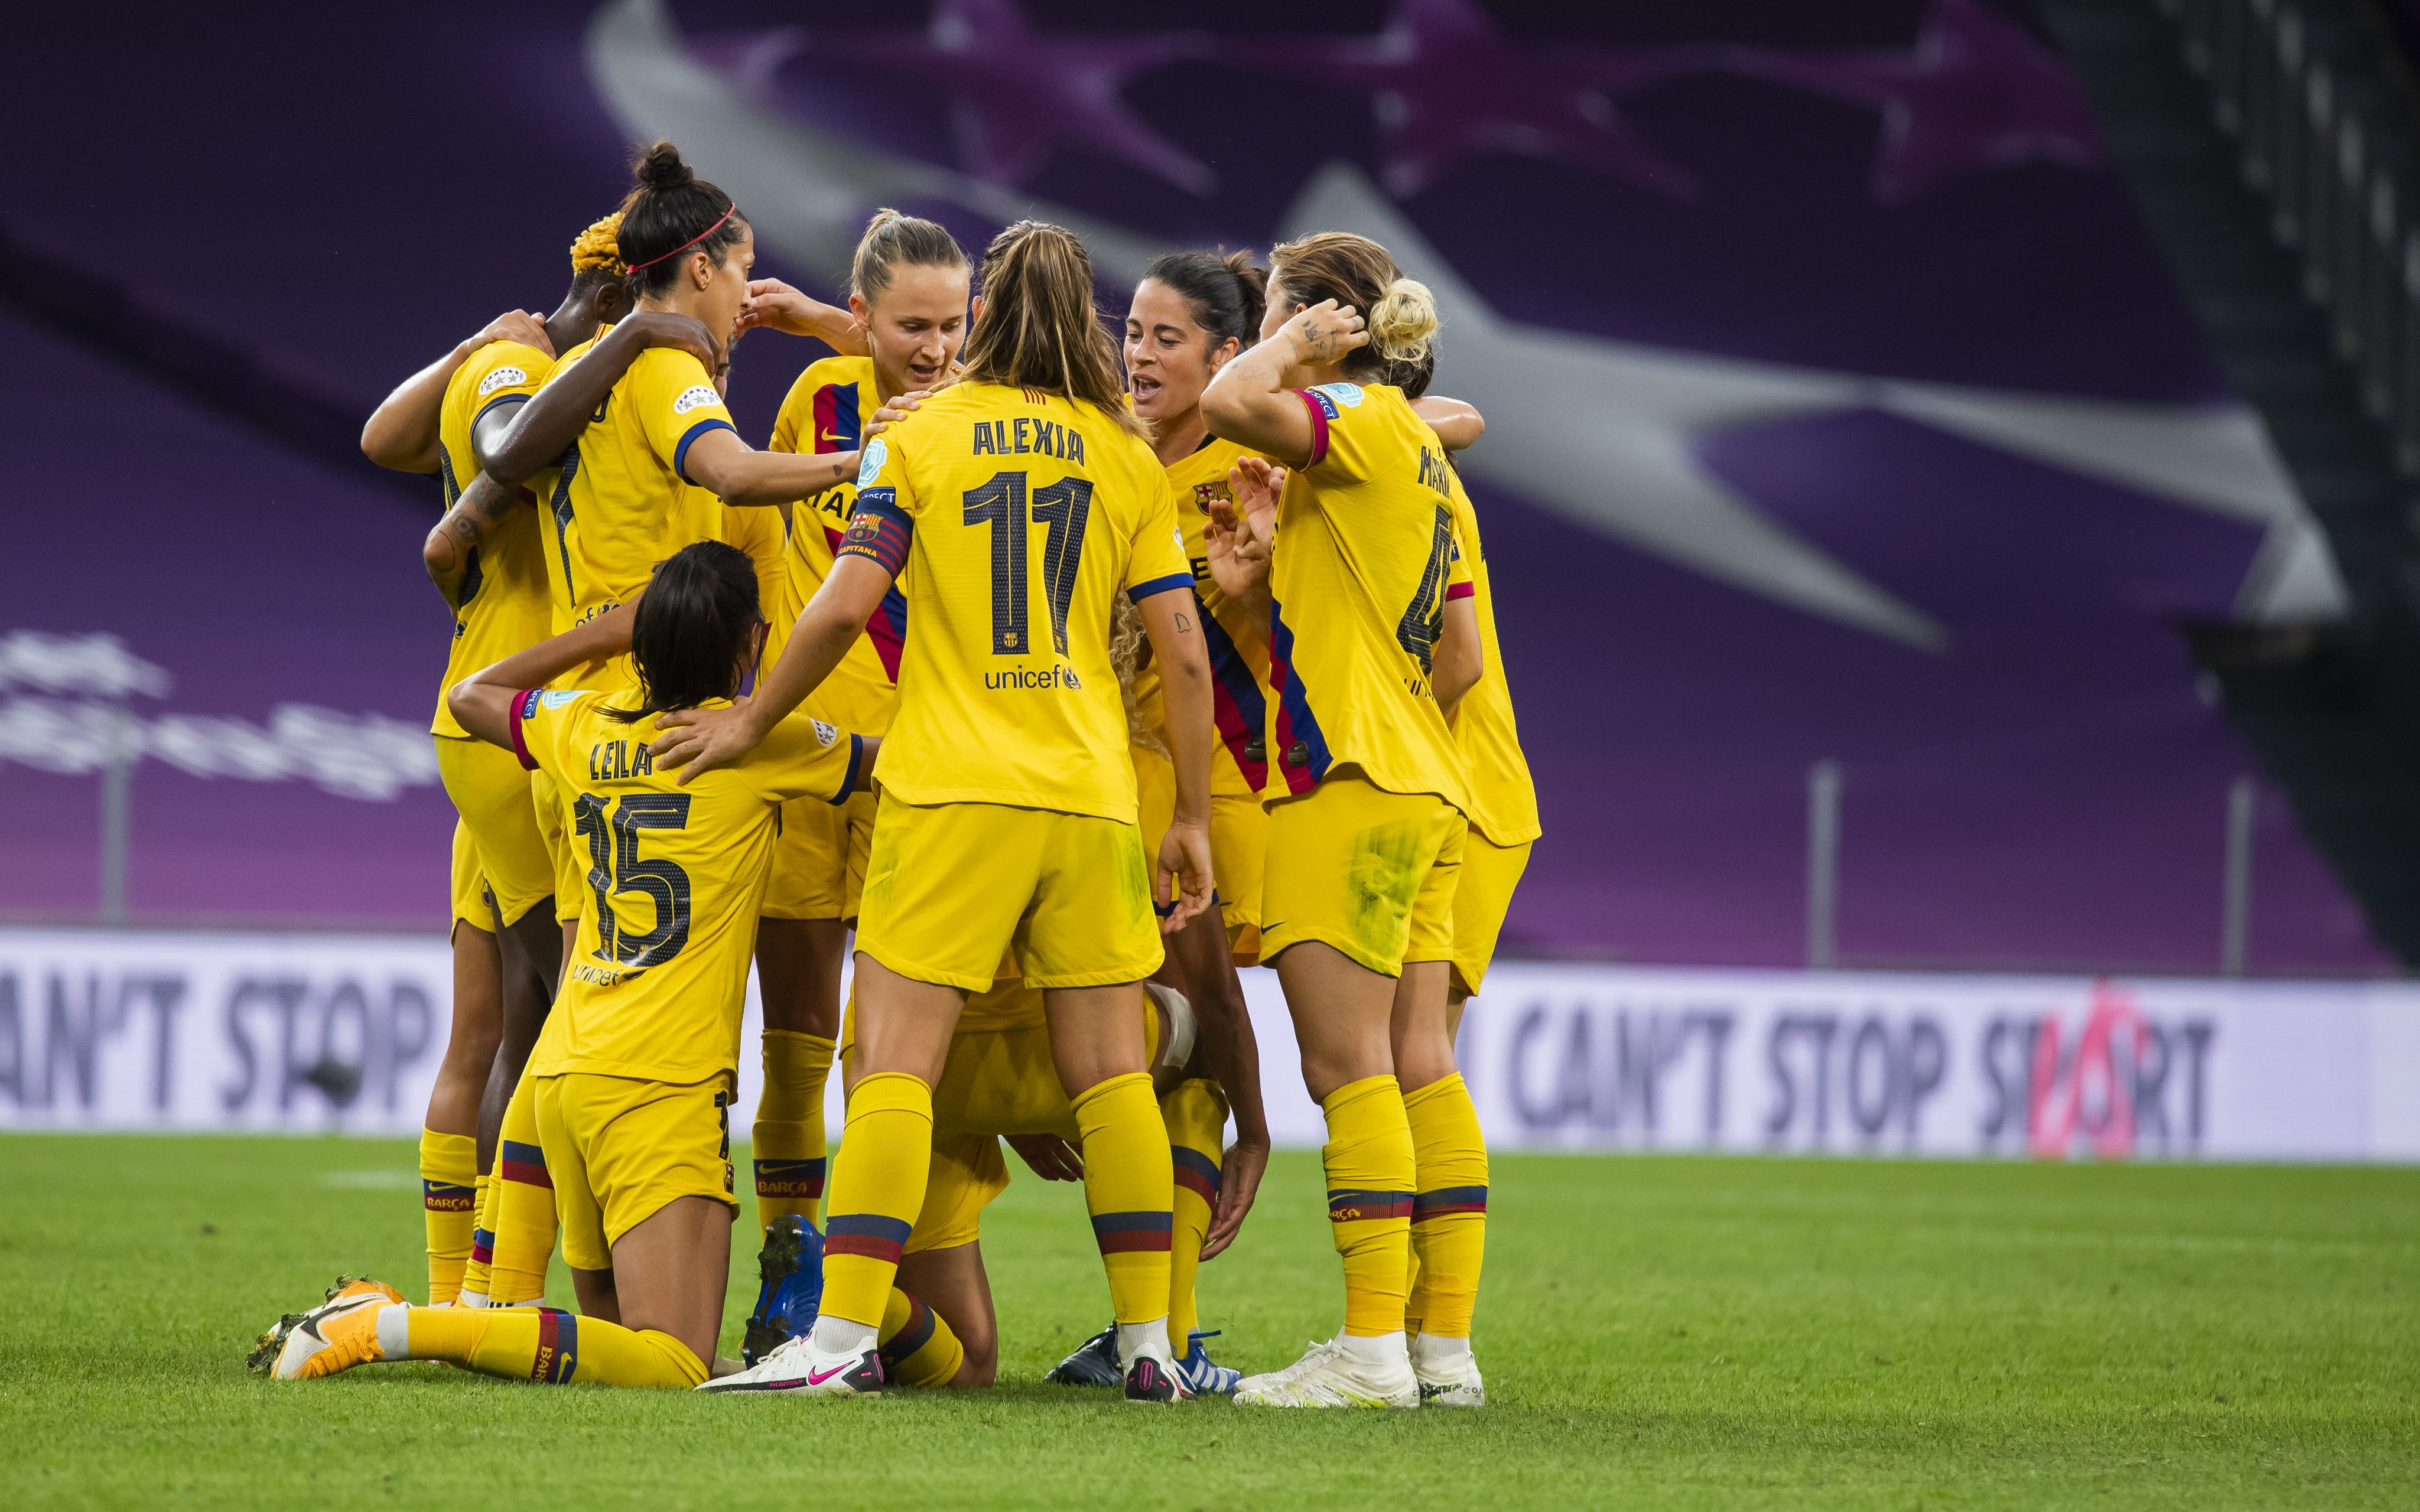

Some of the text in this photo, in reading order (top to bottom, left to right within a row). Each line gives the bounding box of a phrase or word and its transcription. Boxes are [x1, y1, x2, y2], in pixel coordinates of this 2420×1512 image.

[1305, 390, 1336, 418] SPECT
[972, 417, 1085, 467] ALEXIA
[839, 545, 877, 558] CAPITANA
[962, 471, 1095, 659] 11
[1396, 504, 1452, 678] 4
[985, 664, 1061, 690] unicef
[524, 689, 542, 718] SPECT
[590, 739, 653, 781] LEILA
[573, 791, 692, 968] 15
[572, 963, 623, 987] unicef
[0, 969, 434, 1113] AN'T STOP
[1508, 1001, 1735, 1132] CAN'T
[1765, 1009, 1946, 1138] STOP
[427, 1197, 470, 1211] BARÇA
[759, 1181, 808, 1196] BARÇA
[534, 1346, 553, 1382] BAR
